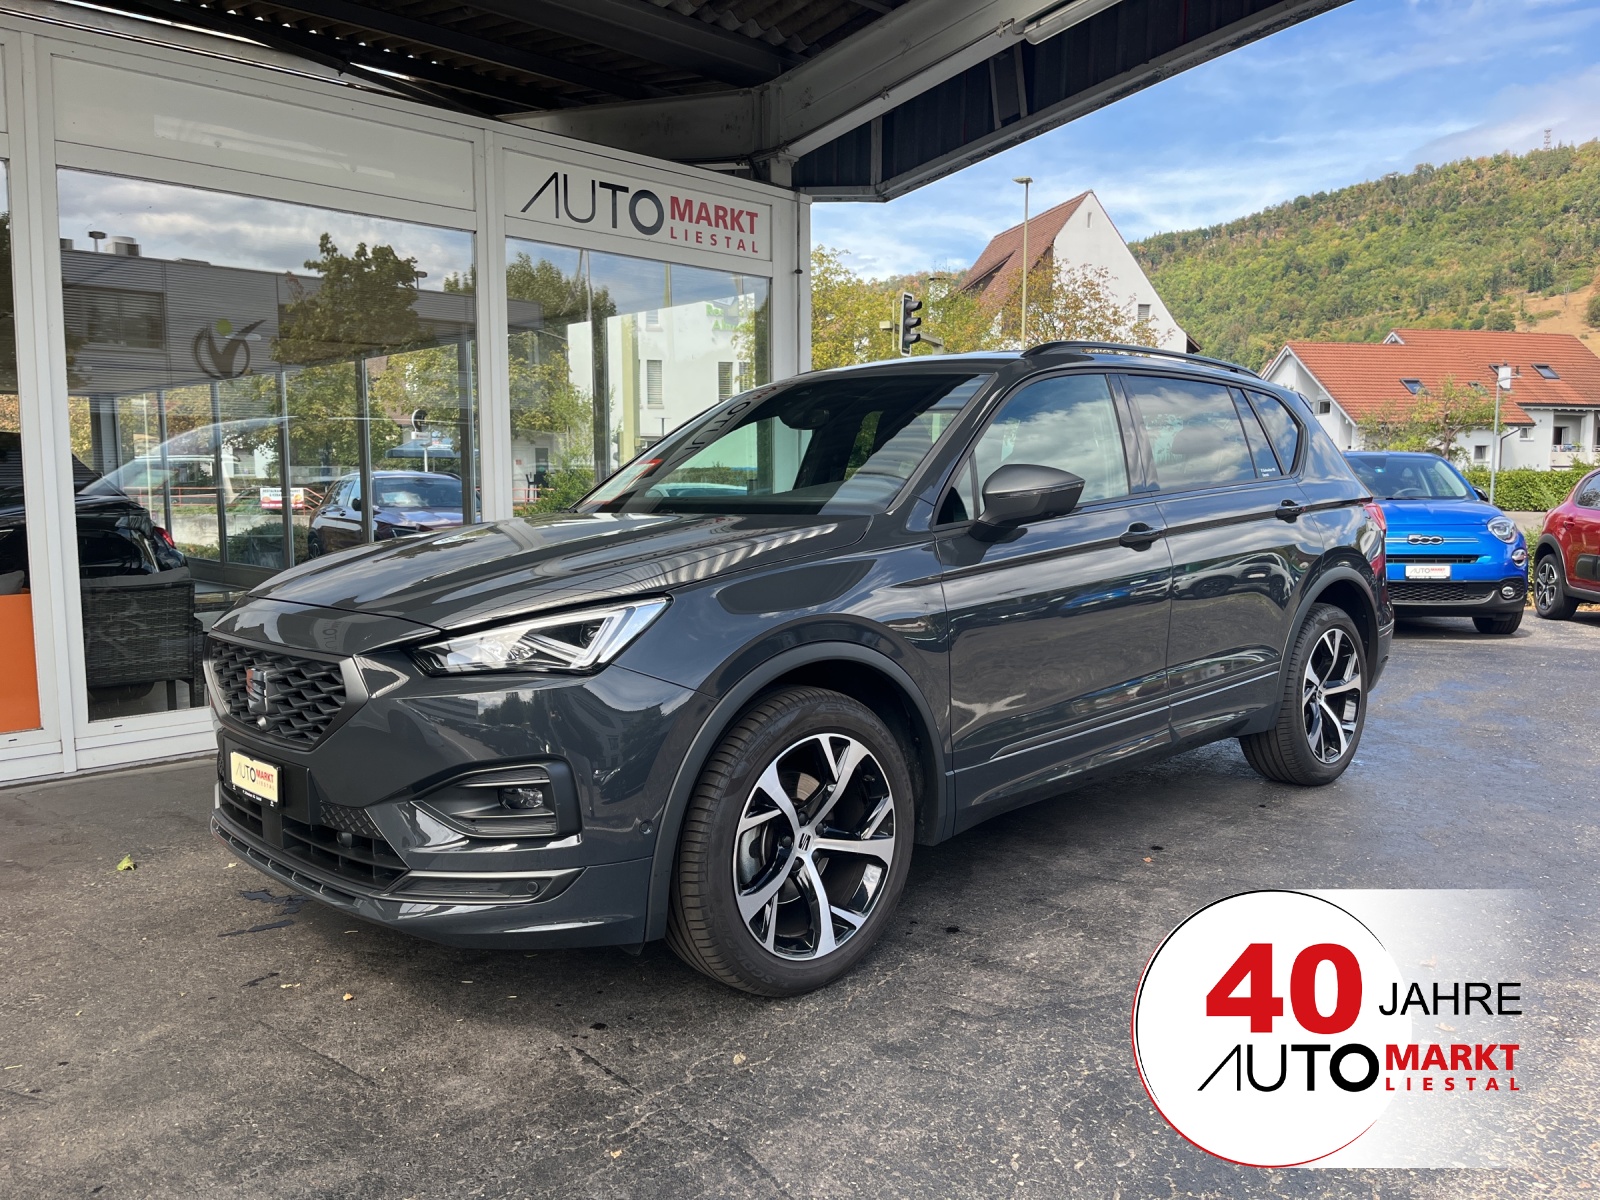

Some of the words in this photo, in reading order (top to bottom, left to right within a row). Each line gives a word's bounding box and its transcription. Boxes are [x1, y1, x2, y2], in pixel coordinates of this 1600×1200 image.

[521, 171, 664, 235] AUTO
[669, 195, 759, 235] MARKT
[669, 226, 759, 253] LIESTAL
[1408, 534, 1443, 545] 500
[236, 762, 256, 782] AUTO
[256, 769, 274, 783] MARKT
